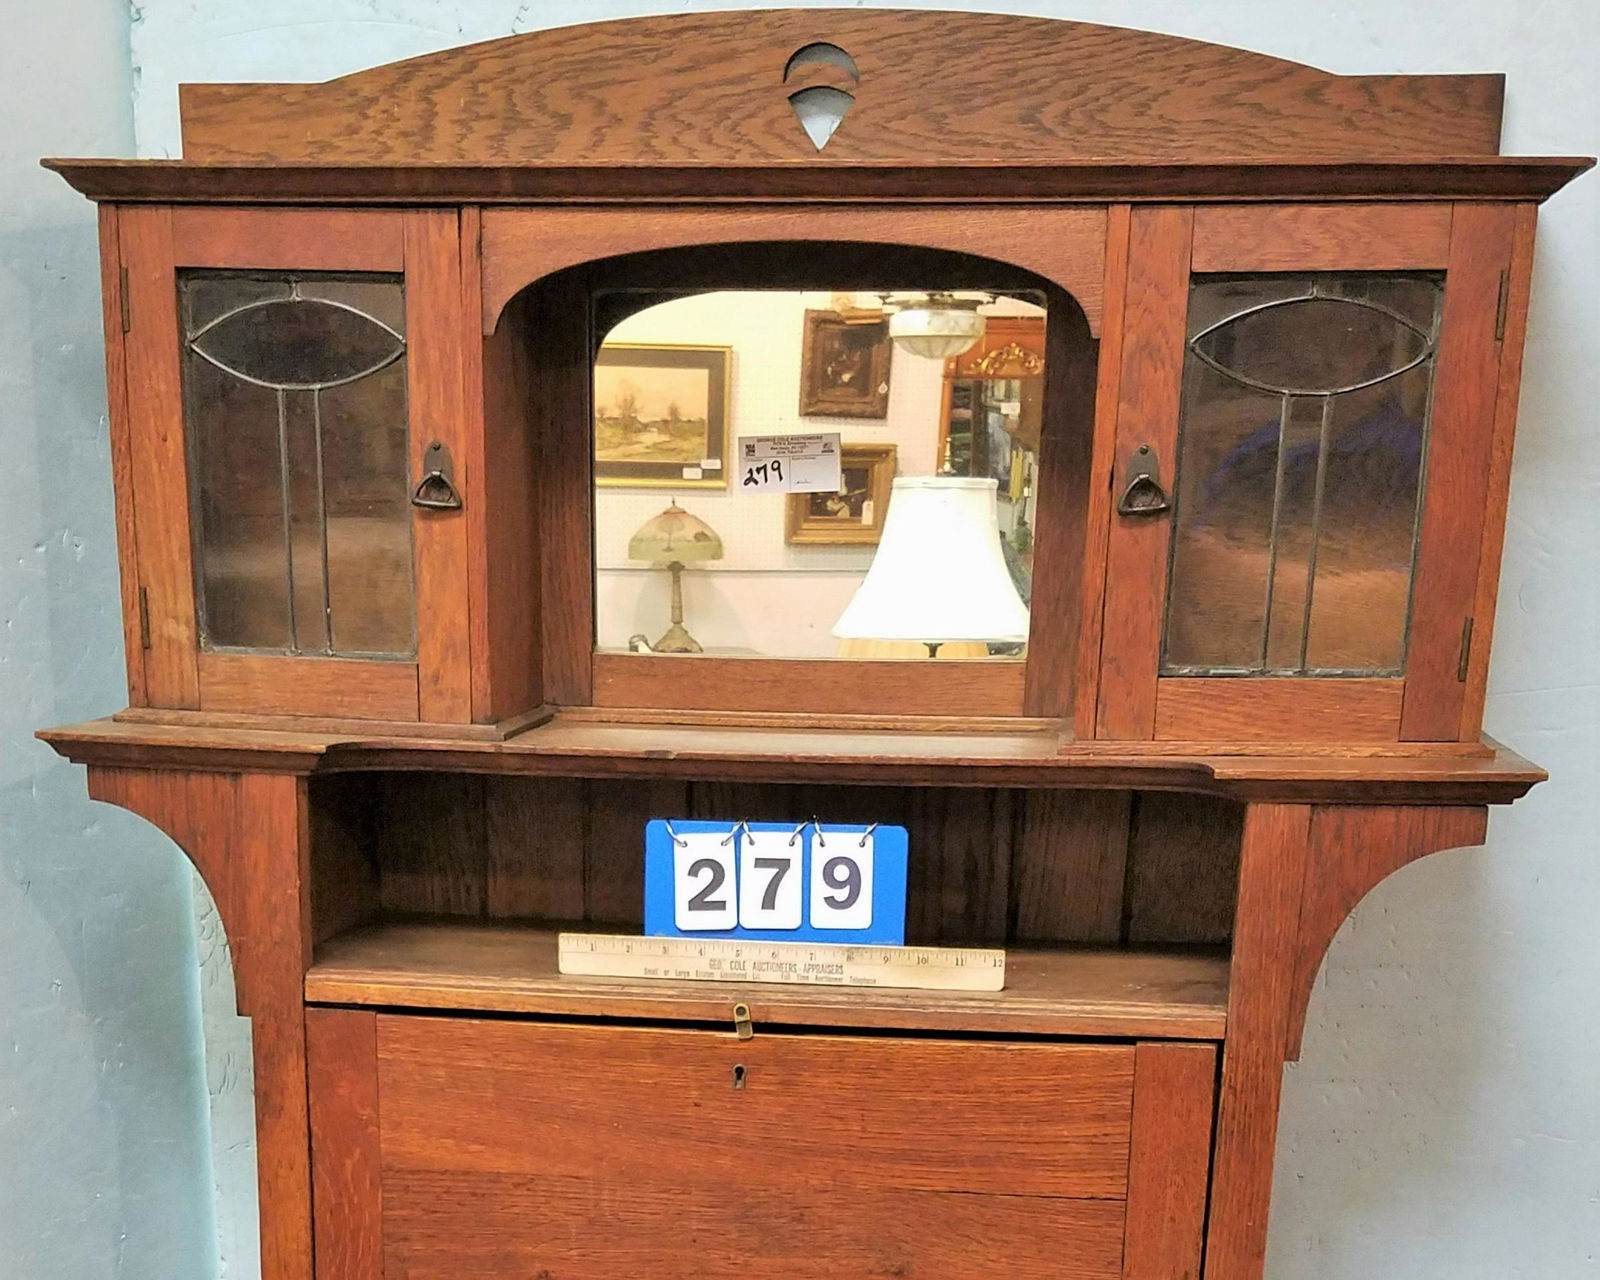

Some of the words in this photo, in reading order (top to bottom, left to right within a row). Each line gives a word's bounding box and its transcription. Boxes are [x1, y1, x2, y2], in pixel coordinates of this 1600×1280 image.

[743, 460, 783, 486] 279
[687, 856, 862, 911] 279
[698, 947, 703, 956] 4
[735, 949, 741, 958] 5
[771, 951, 777, 959] 6
[883, 955, 889, 964] 9
[916, 955, 927, 965] 10
[955, 957, 964, 967] 11
[993, 958, 1003, 968] 12
[729, 960, 746, 972] COLE
[803, 963, 844, 975] APPRAISERS
